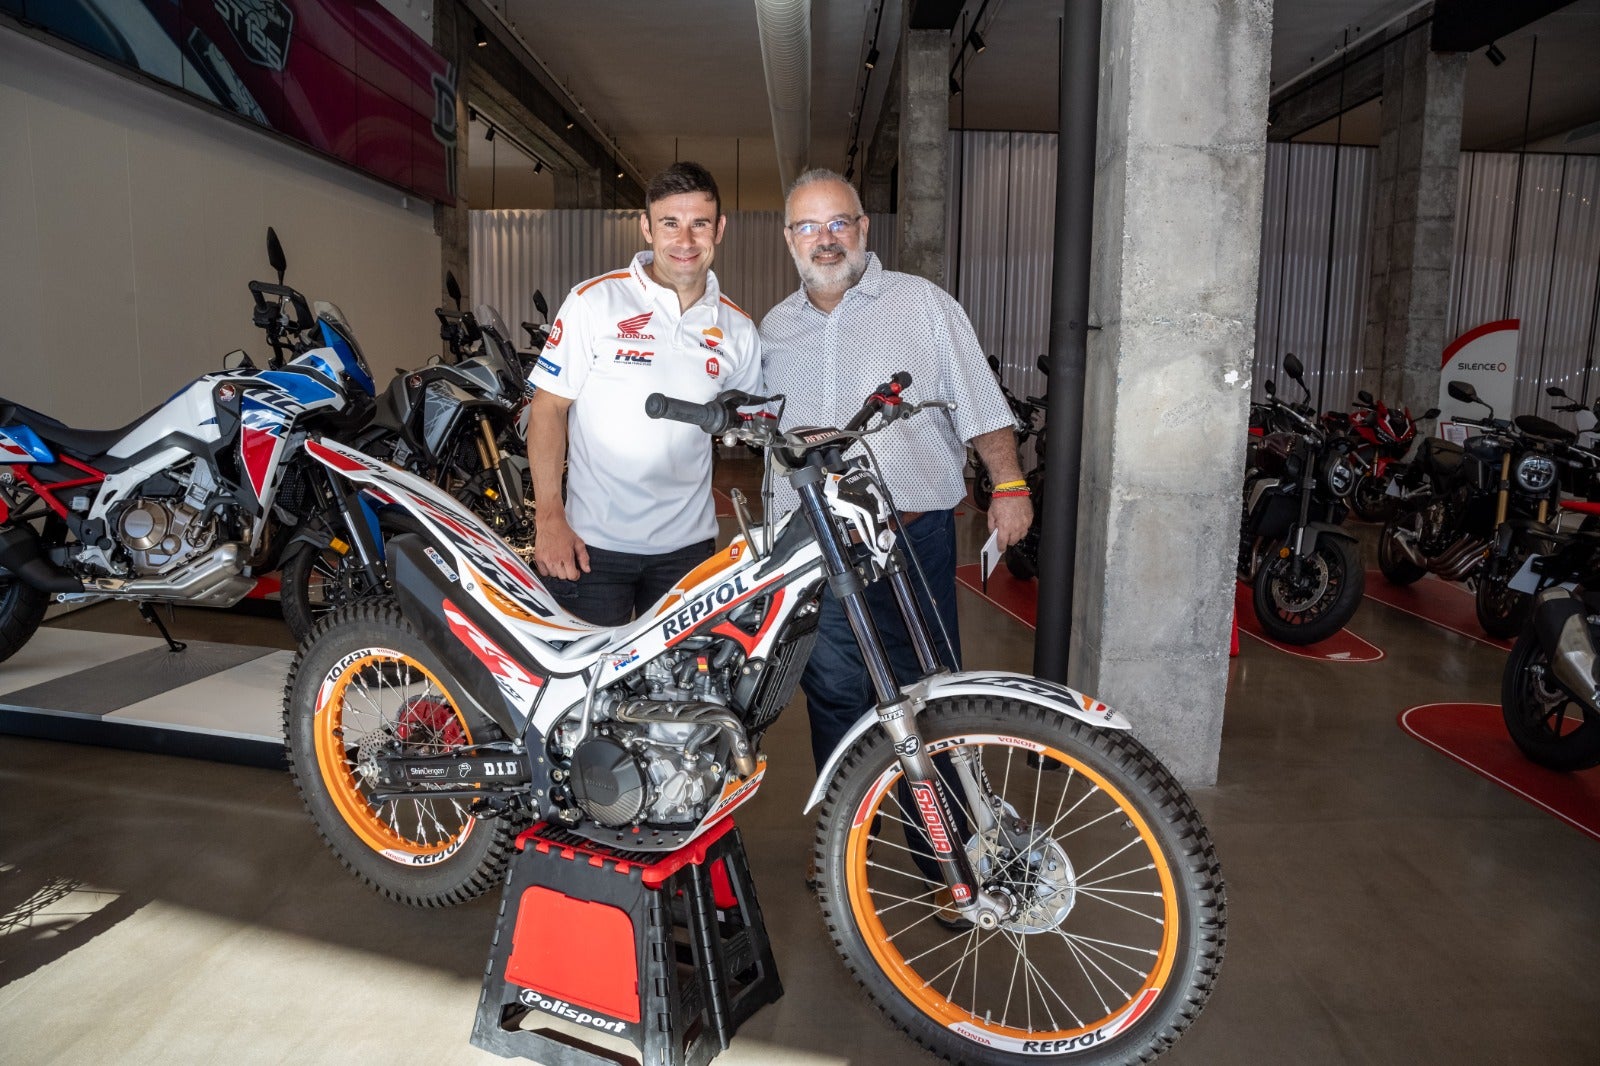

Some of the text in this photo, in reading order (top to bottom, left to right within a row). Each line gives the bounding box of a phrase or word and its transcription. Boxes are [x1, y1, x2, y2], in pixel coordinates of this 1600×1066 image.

[614, 349, 655, 362] HRC
[1458, 362, 1496, 371] SILENCE
[662, 576, 749, 641] REPSOL
[327, 650, 371, 682] REPSOL
[880, 709, 904, 722] ALFER
[998, 736, 1036, 749] HONDA
[913, 783, 953, 853] SHOWA
[412, 841, 462, 864] REPSOL
[524, 991, 627, 1033] Polisport
[956, 1027, 1106, 1053] HONDA REPSOL
